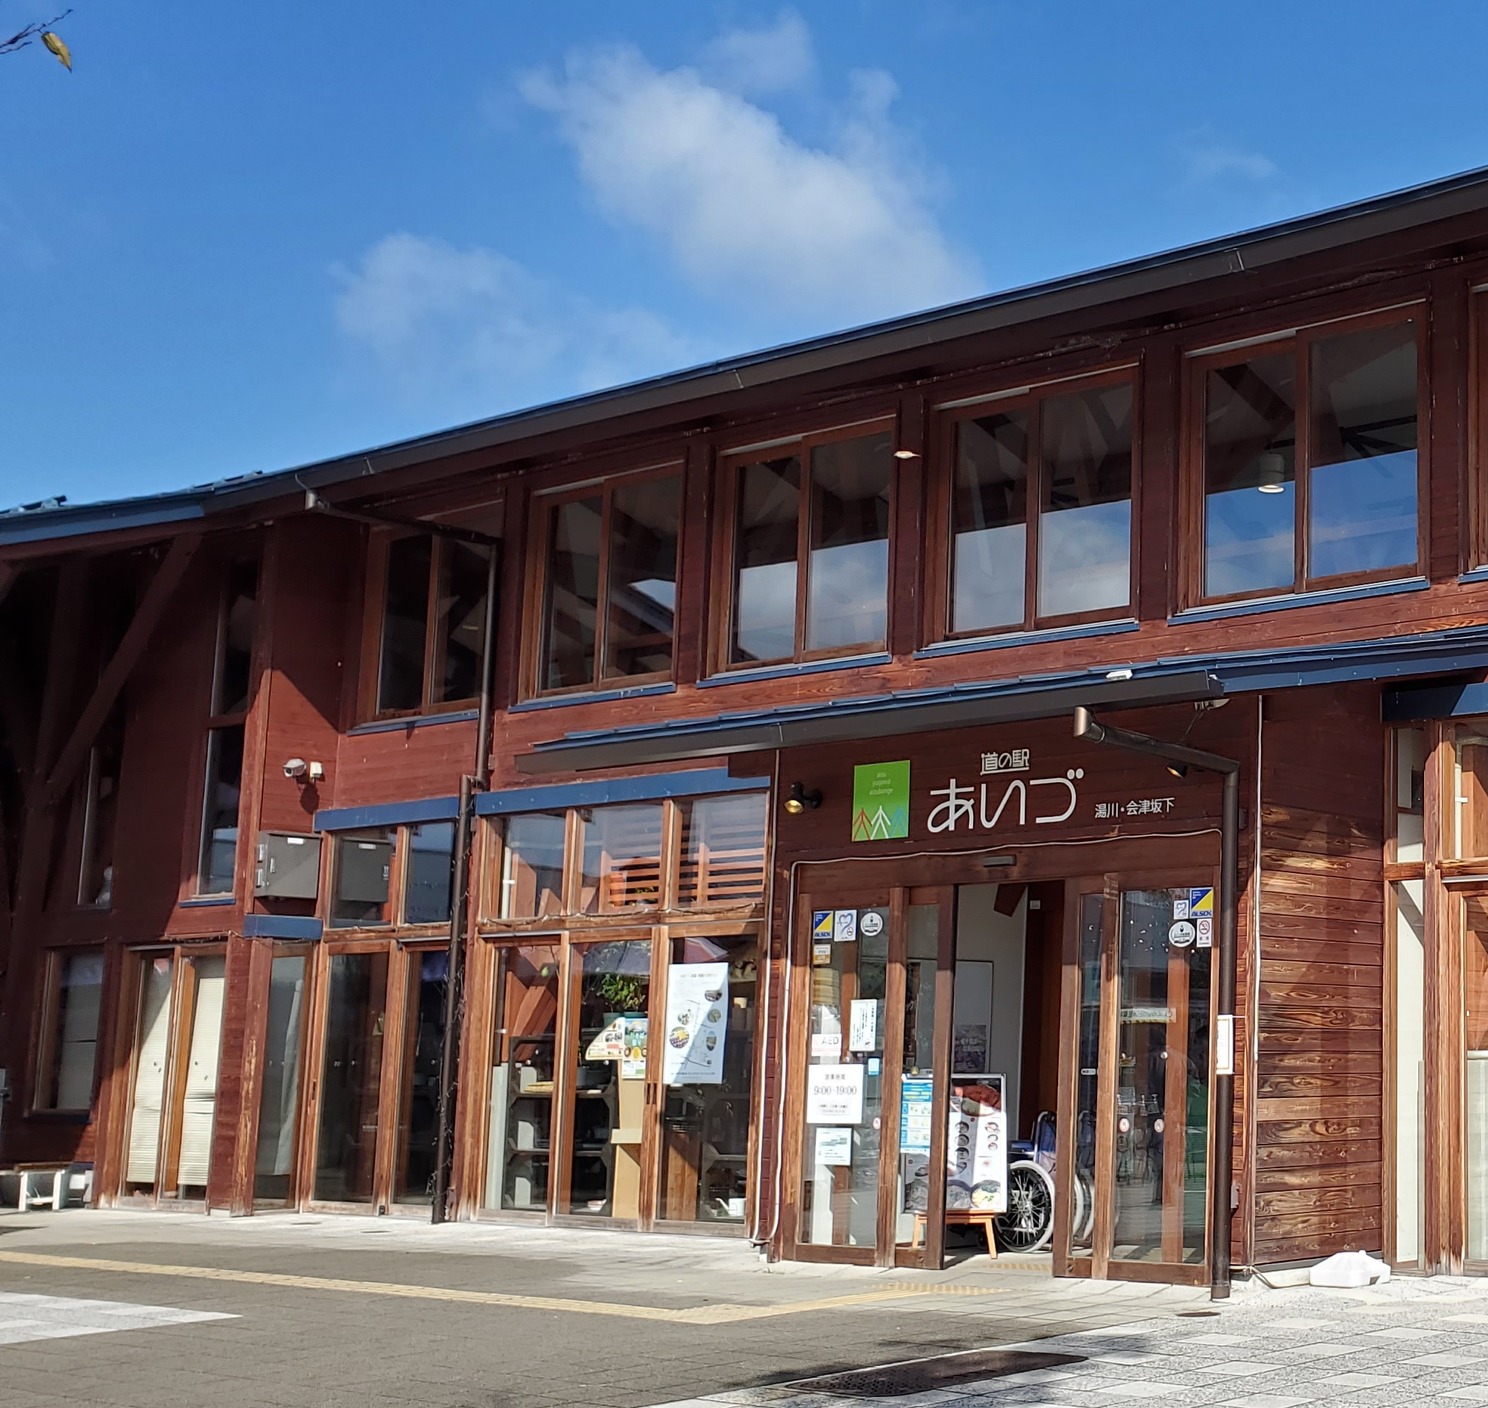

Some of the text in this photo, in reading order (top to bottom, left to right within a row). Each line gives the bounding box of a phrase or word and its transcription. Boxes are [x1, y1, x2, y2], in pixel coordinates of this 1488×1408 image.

[980, 749, 1030, 775] 道の駅
[927, 768, 1085, 833] あいづ
[1094, 797, 1176, 819] 湯川・会津坂下
[821, 1036, 840, 1045] AED
